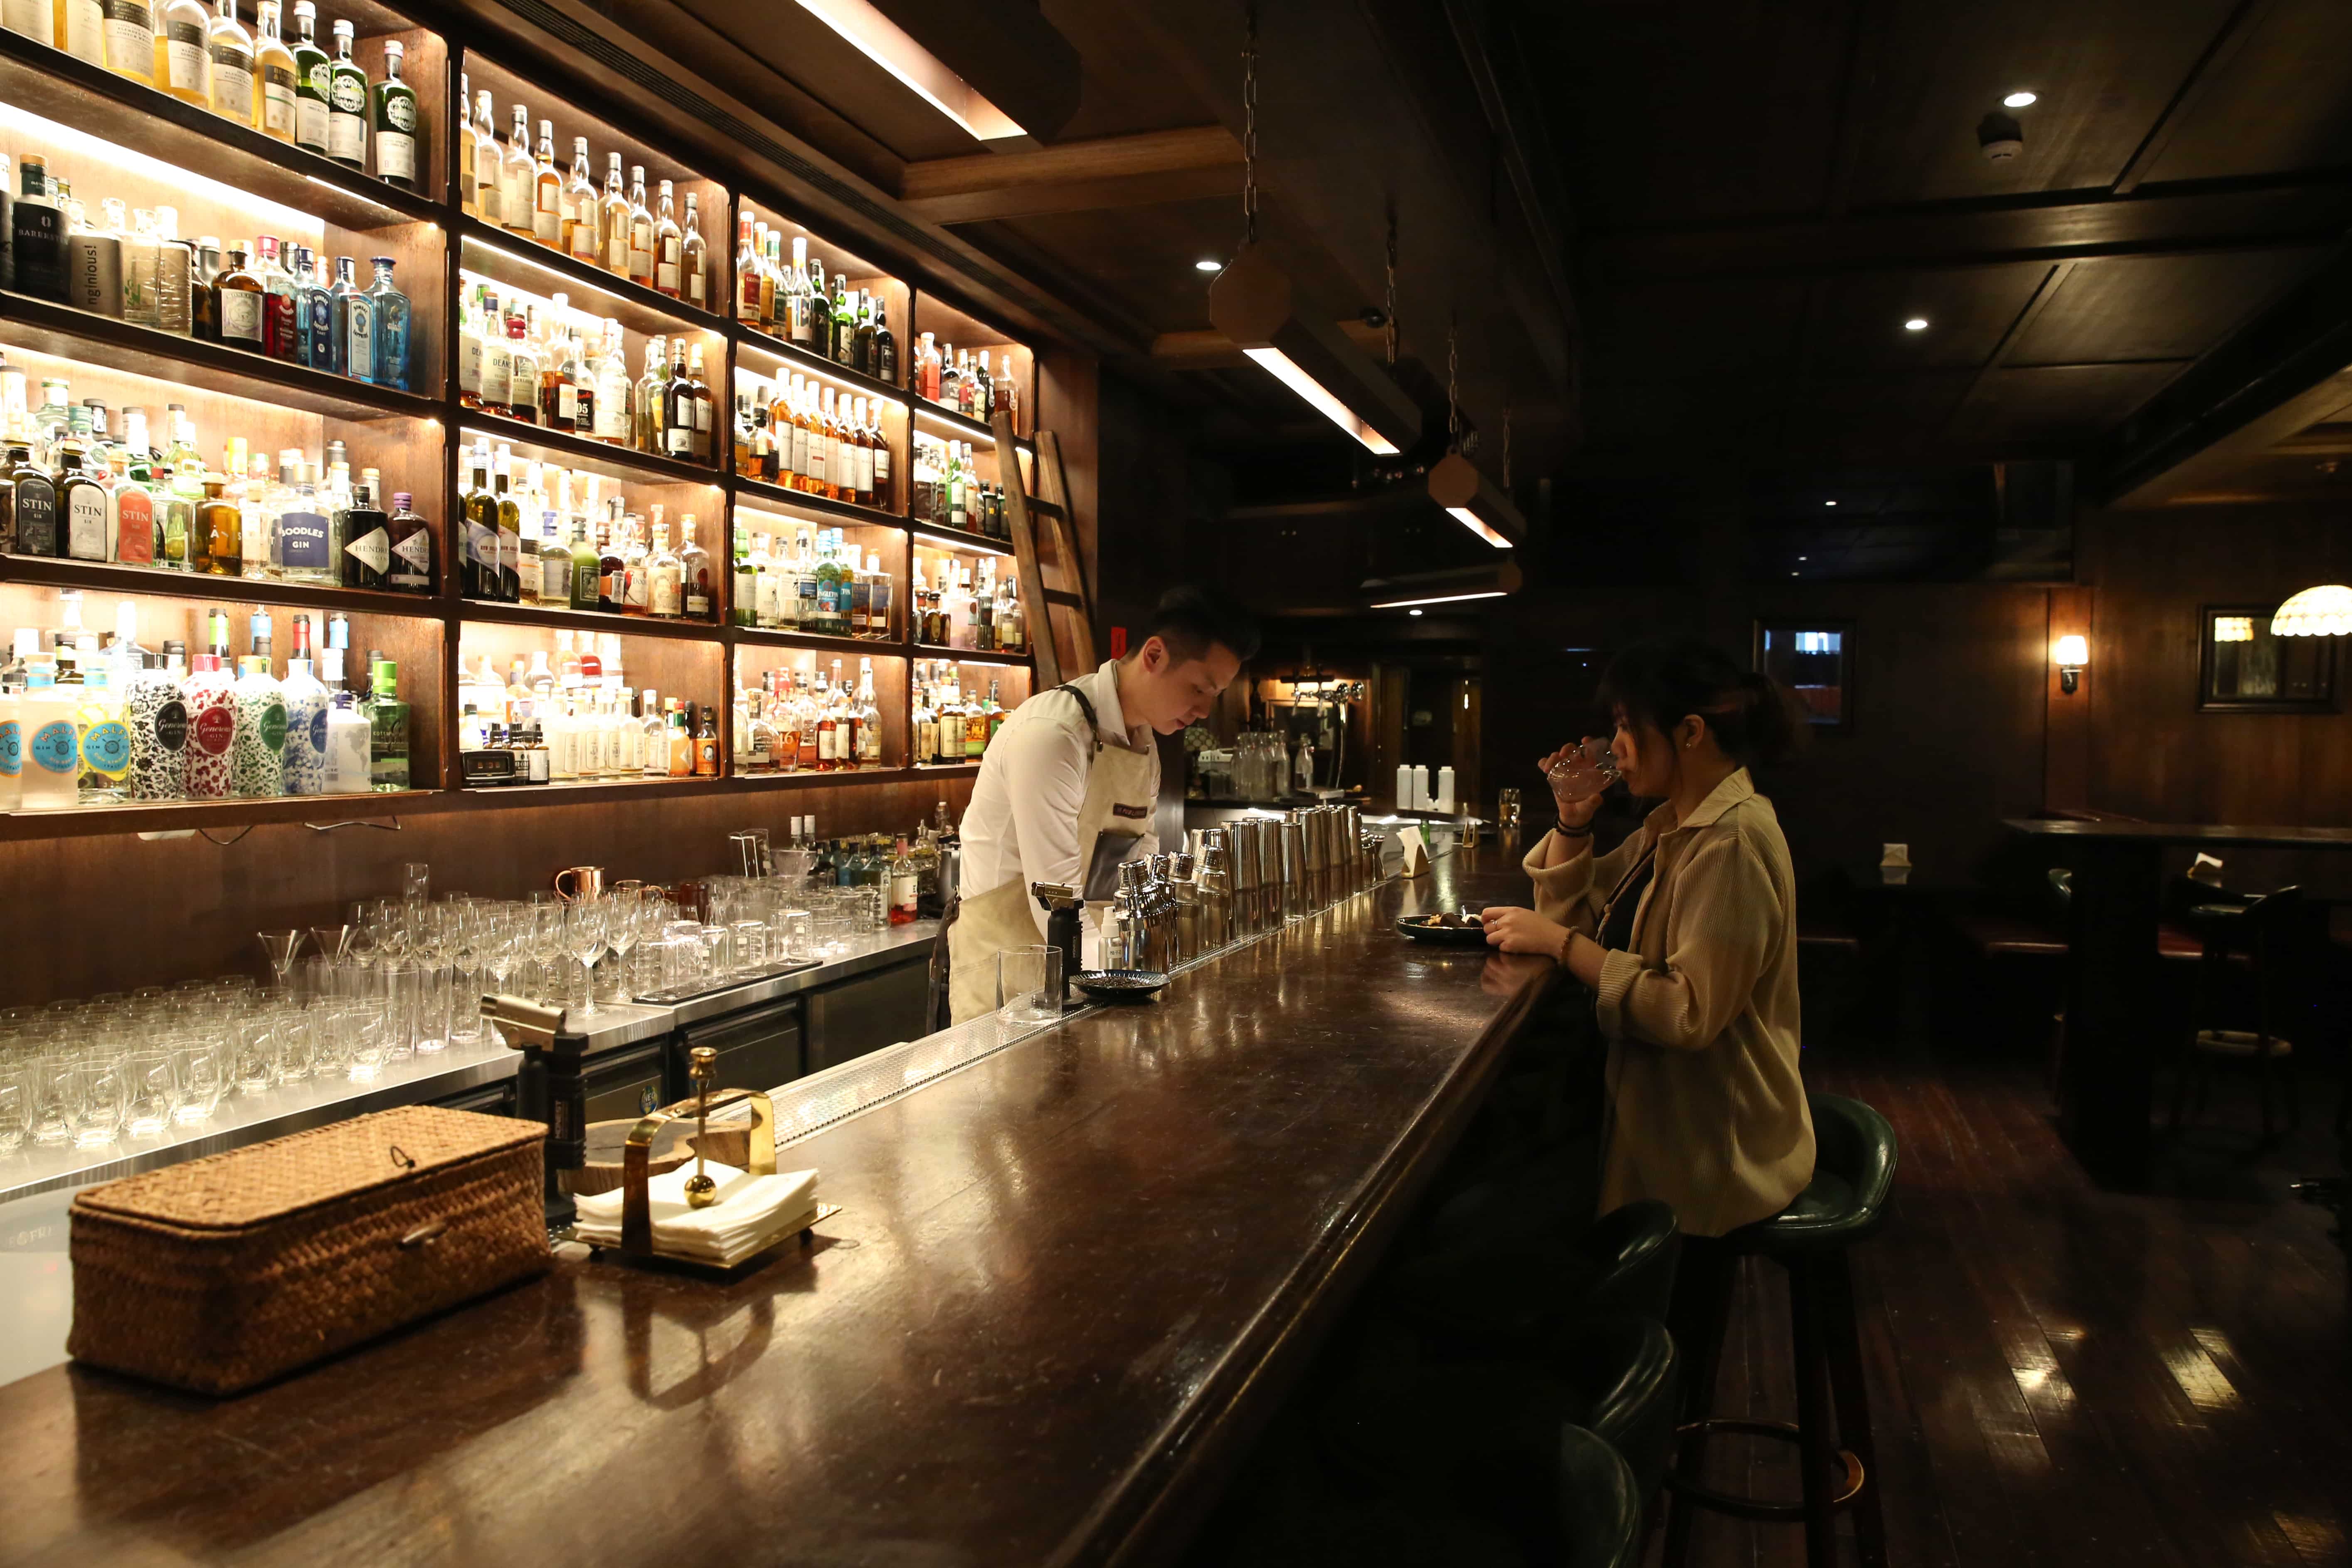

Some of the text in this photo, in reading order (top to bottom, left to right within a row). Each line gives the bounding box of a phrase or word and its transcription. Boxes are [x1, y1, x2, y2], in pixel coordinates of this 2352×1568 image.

[84, 245, 101, 305] nginious!
[22, 498, 52, 511] STIN
[74, 504, 102, 516] STIN
[123, 510, 148, 522] STIN
